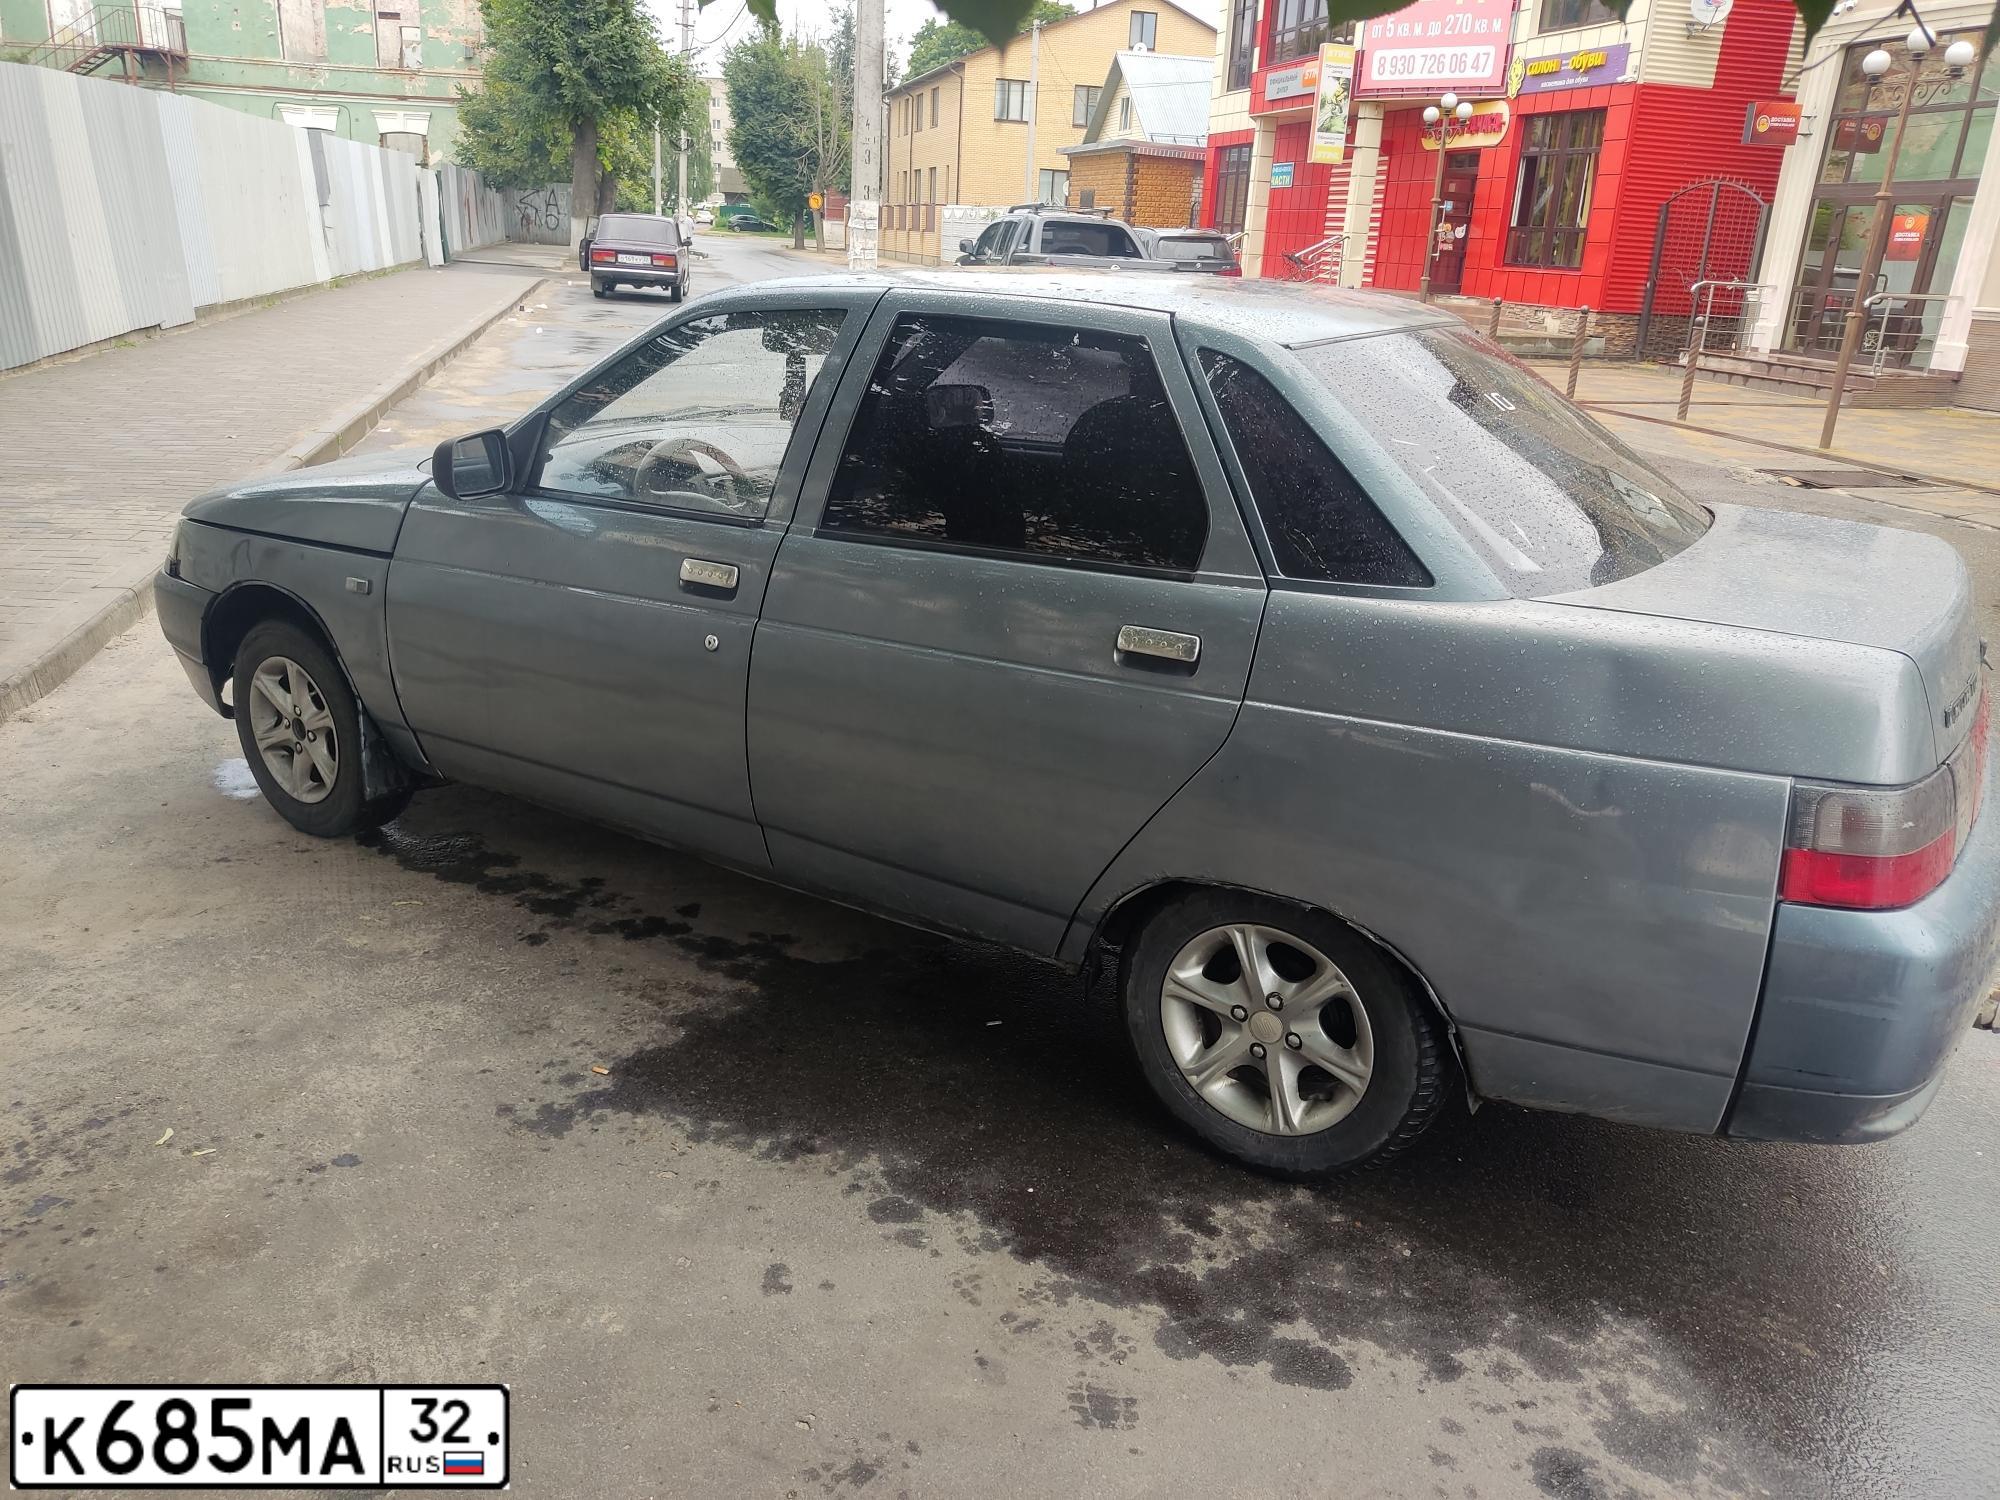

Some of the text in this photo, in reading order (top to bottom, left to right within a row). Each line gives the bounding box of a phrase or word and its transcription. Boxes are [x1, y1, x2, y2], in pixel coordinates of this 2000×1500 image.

[1385, 16, 1396, 38] 5
[1444, 12, 1473, 36] 270
[1377, 51, 1491, 76] 8 930 726 06 47
